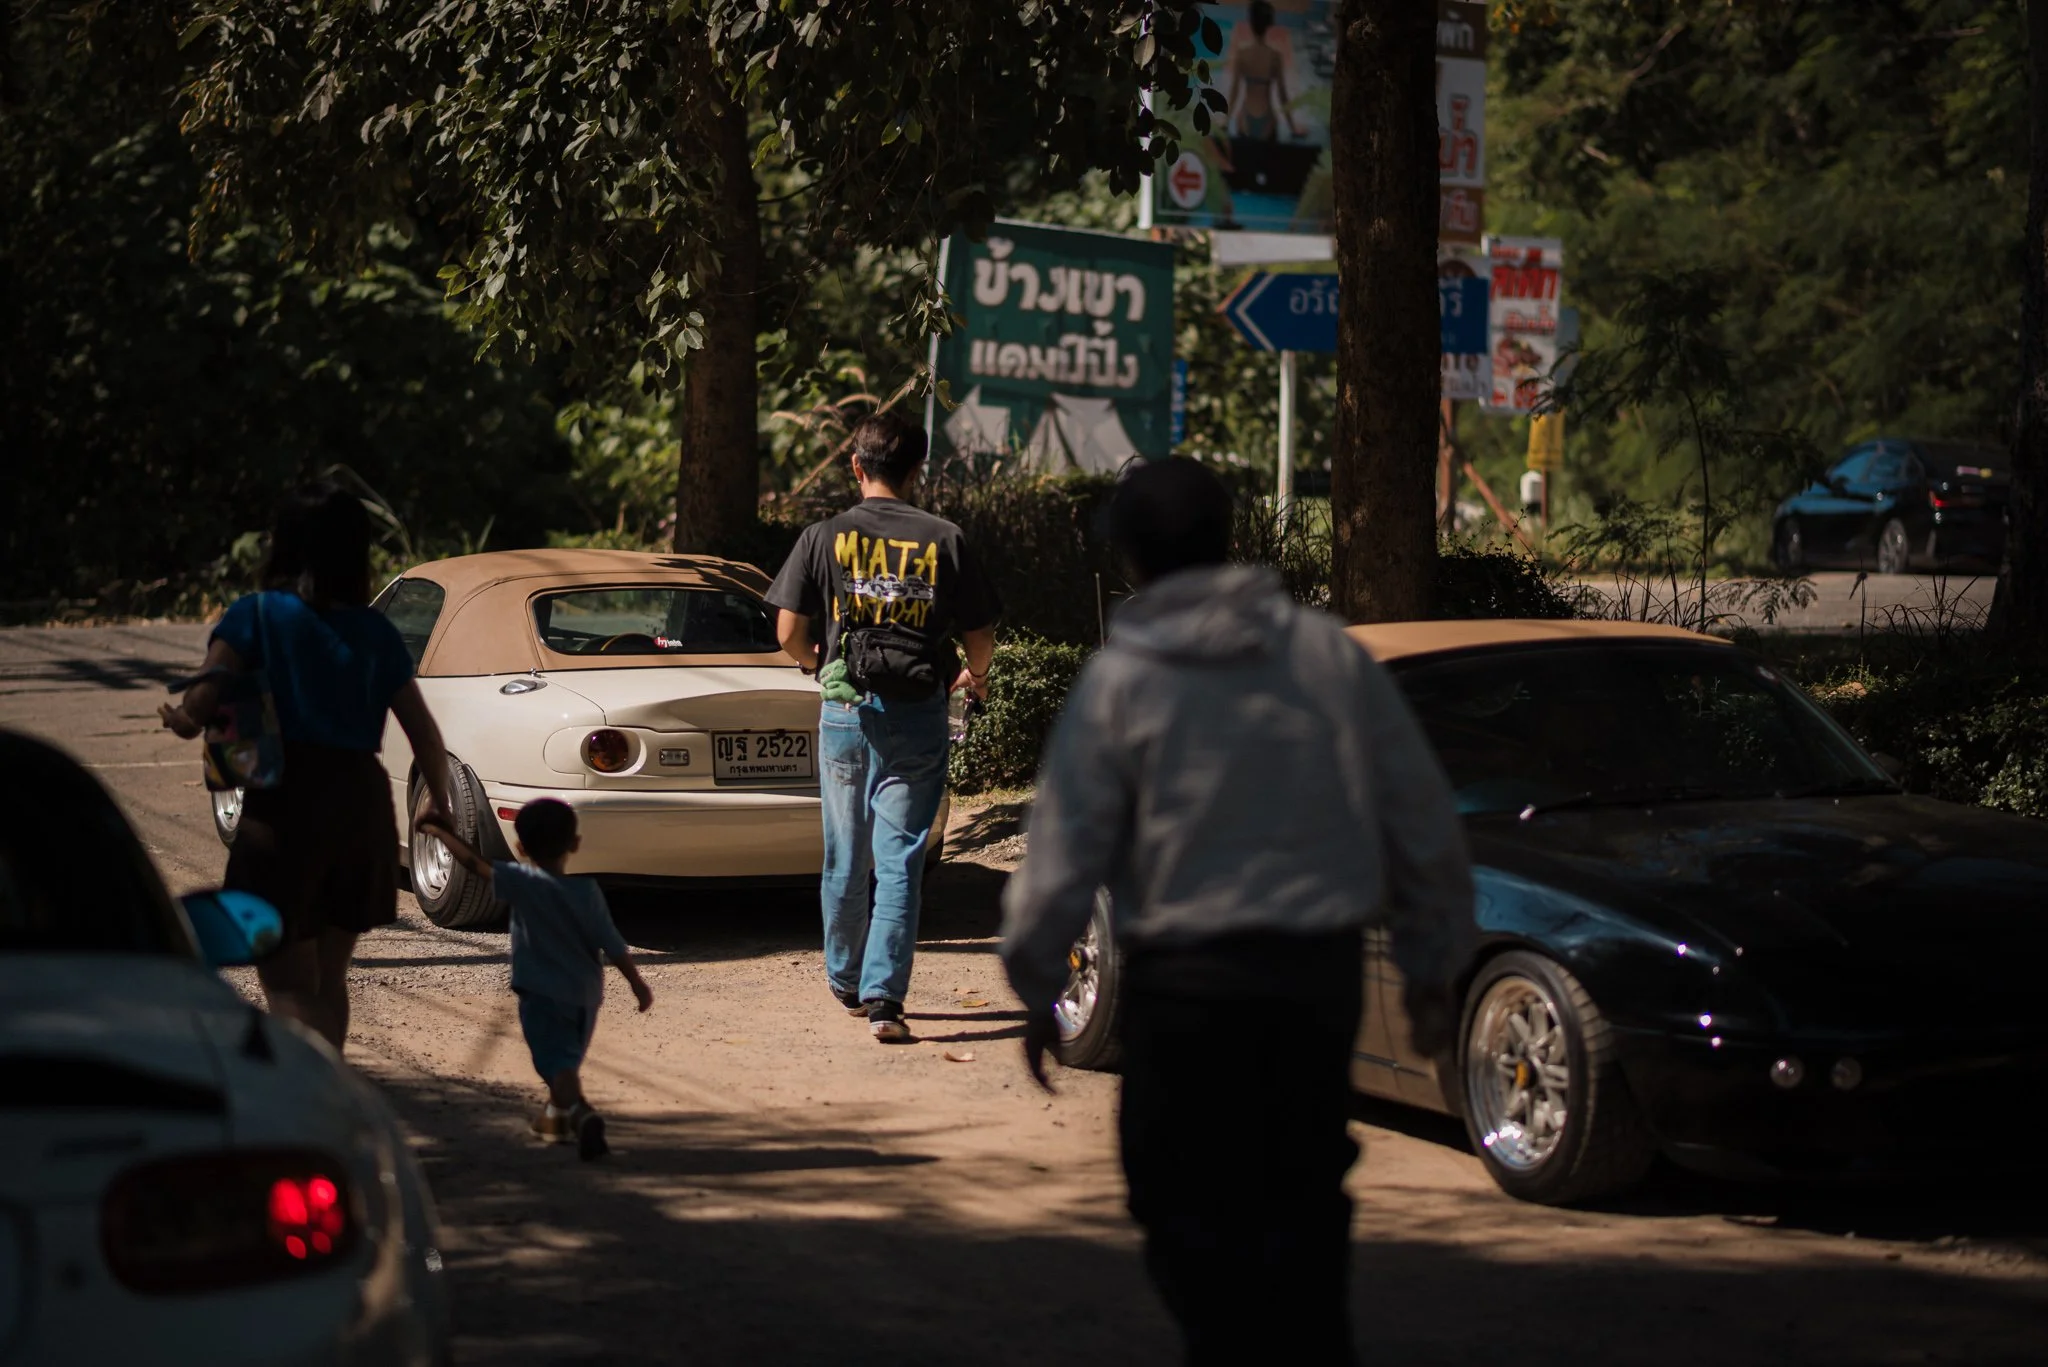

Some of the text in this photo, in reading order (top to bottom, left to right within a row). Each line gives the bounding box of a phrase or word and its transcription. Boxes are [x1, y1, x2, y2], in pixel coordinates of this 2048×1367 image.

[971, 236, 1146, 321] ข้างเขา
[834, 530, 938, 586] MIATA
[716, 735, 808, 761] ญฐ 2522
[729, 764, 798, 777] กรุงเทพมหานคร
